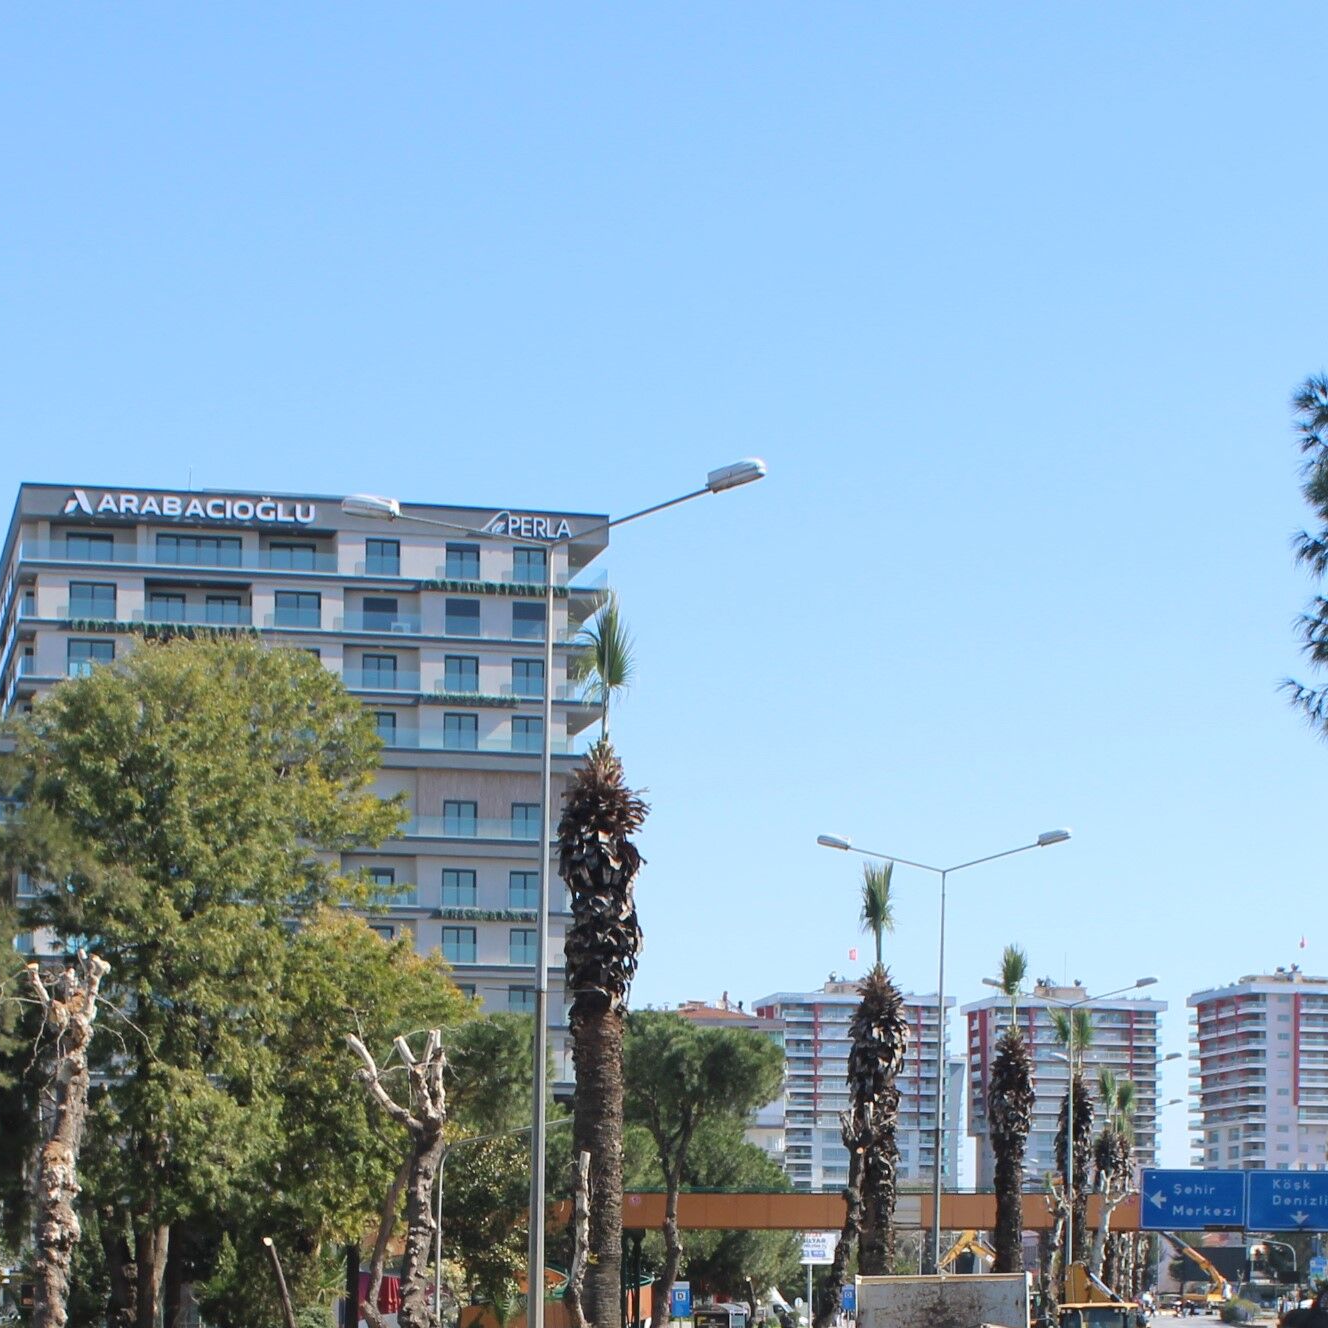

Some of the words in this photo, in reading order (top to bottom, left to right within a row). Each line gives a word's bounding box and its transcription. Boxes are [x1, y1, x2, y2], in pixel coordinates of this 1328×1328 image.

[97, 493, 316, 524] ARABACIOĞLU
[508, 516, 572, 539] PERLA
[1173, 1183, 1216, 1196] Şehir
[1272, 1178, 1311, 1191] Köşk
[1272, 1194, 1328, 1207] Denizli
[1172, 1205, 1237, 1217] Merkezi
